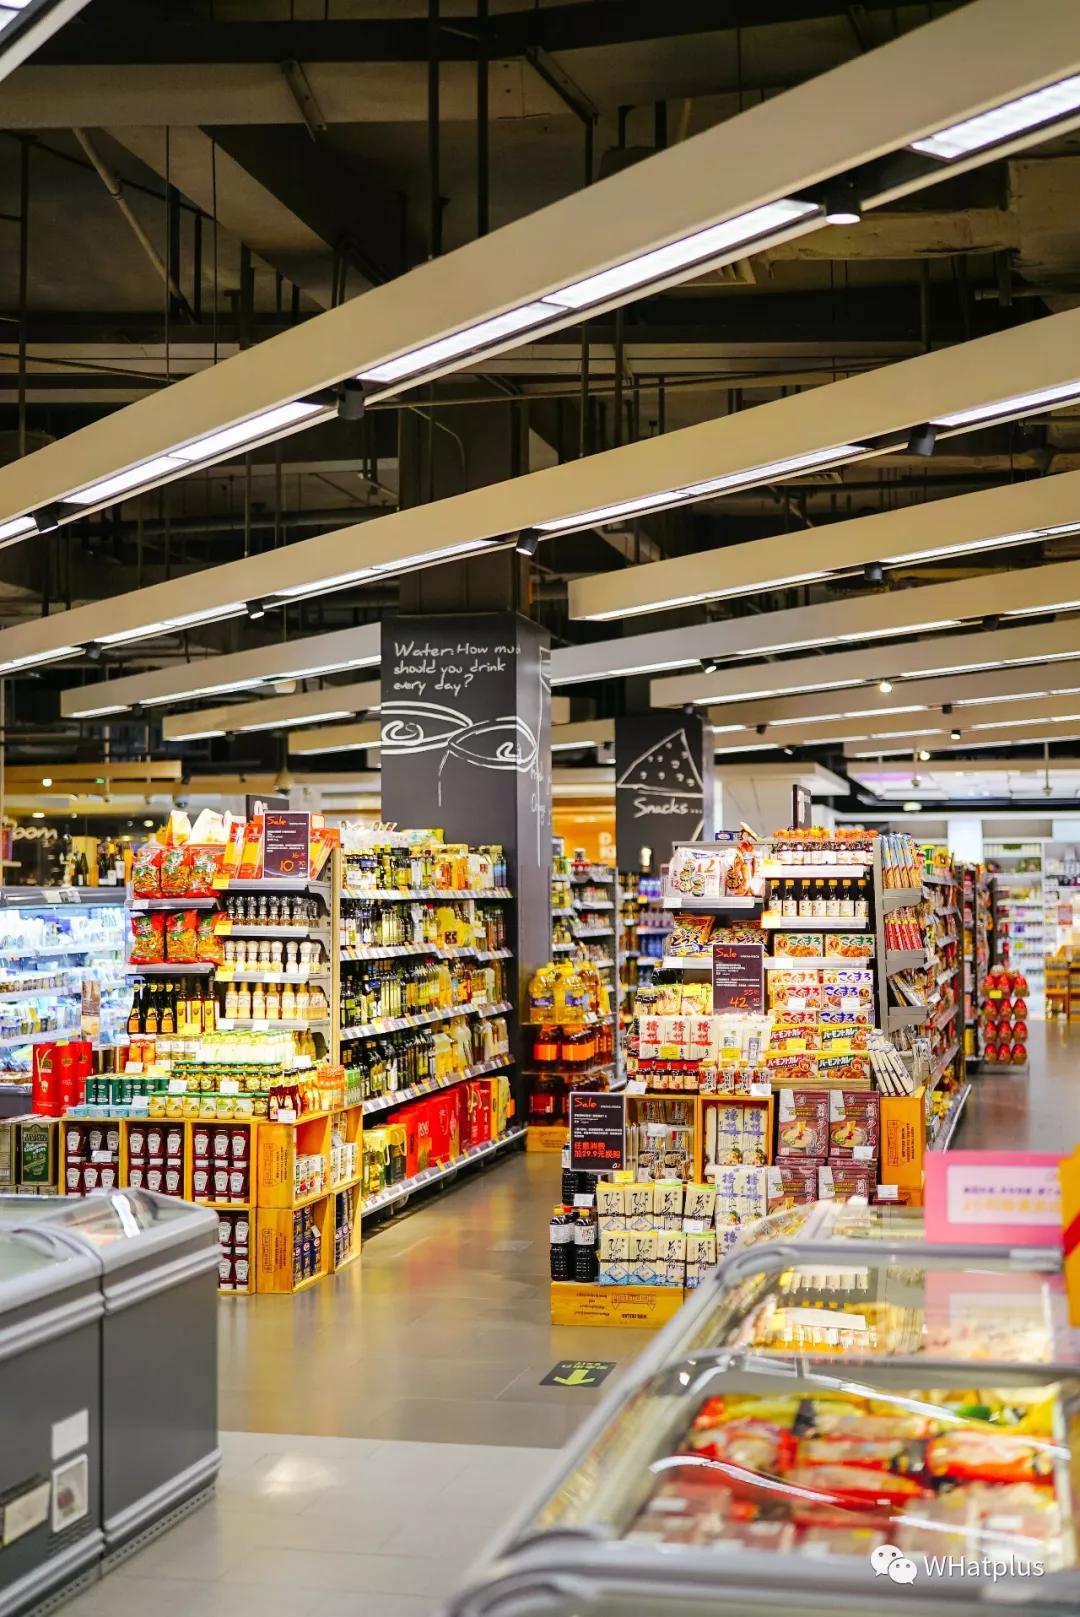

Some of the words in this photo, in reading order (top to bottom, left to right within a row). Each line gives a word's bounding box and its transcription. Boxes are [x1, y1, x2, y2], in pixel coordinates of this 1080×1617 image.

[393, 658, 437, 675] should
[441, 666, 463, 679] you
[469, 656, 507, 673] drink
[393, 680, 427, 696] every
[434, 673, 474, 697] day?
[729, 996, 749, 1008] 42
[574, 1097, 598, 1109] Sale
